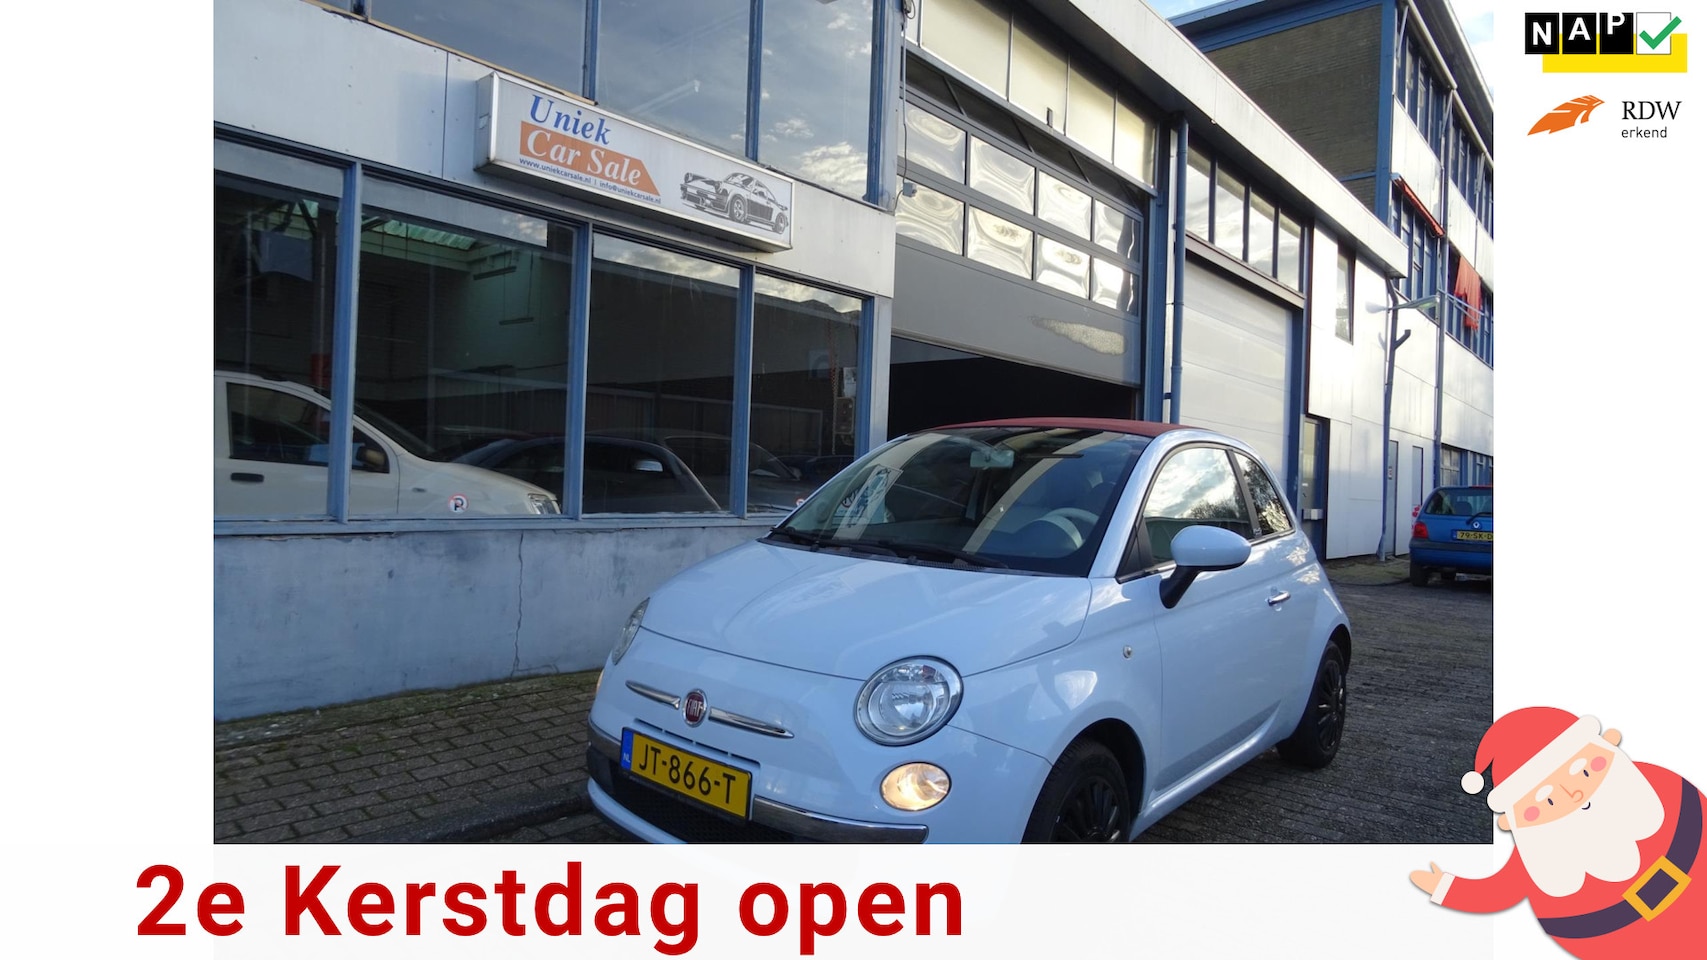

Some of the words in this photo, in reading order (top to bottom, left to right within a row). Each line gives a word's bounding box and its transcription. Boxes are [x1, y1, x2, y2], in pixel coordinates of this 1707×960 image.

[530, 95, 611, 146] Uniek
[519, 157, 592, 185] www.uniekcarsale.nl
[599, 180, 662, 205] info@uniekcarsale.nl
[527, 130, 582, 166] Car
[586, 150, 642, 186] Sale
[687, 699, 704, 717] FIAT
[639, 743, 737, 805] JT-866-T
